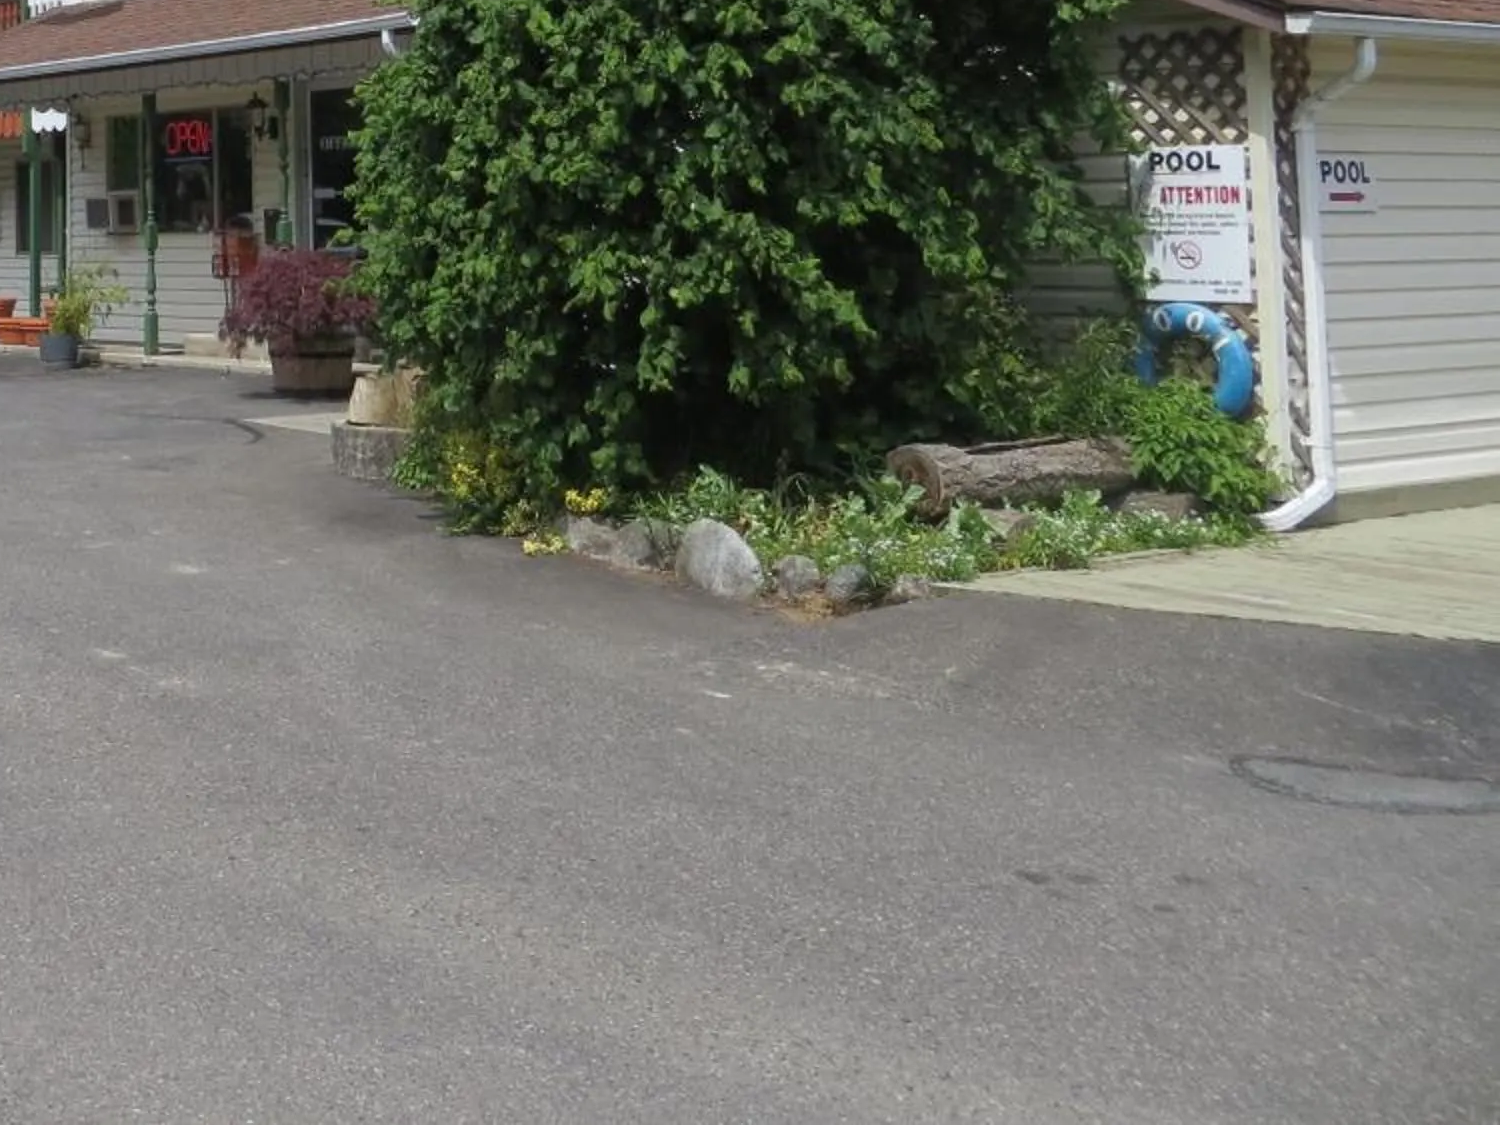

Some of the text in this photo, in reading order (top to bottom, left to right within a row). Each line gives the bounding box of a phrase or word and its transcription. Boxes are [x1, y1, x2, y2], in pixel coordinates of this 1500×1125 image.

[165, 121, 212, 154] OPEN
[1150, 151, 1221, 172] POOL
[1320, 161, 1370, 184] POOL
[1159, 185, 1241, 205] ATTENTION
